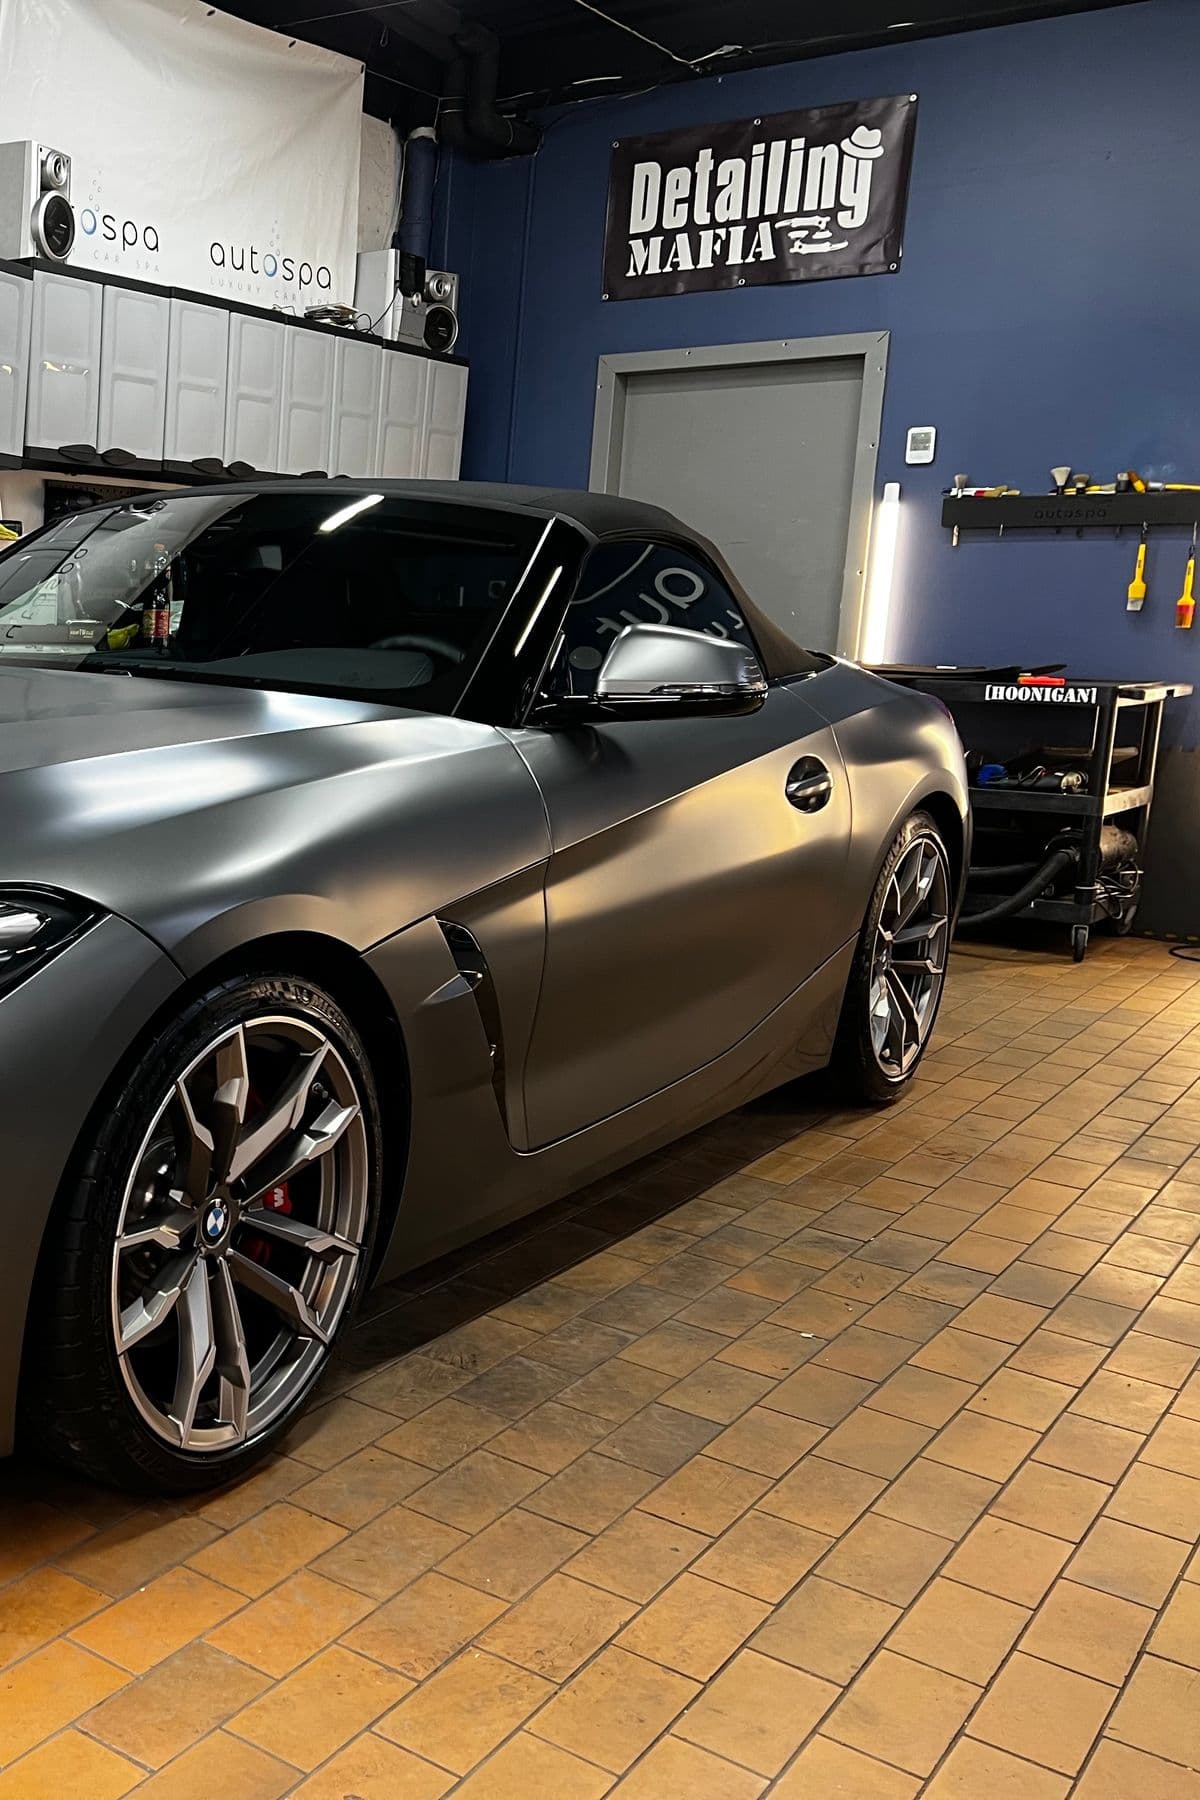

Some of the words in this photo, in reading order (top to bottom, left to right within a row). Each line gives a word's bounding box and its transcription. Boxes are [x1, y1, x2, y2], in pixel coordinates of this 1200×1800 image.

[628, 136, 873, 235] Detailing
[80, 208, 159, 253] ospa
[625, 221, 777, 278] MAFIA
[210, 241, 332, 291] autospa
